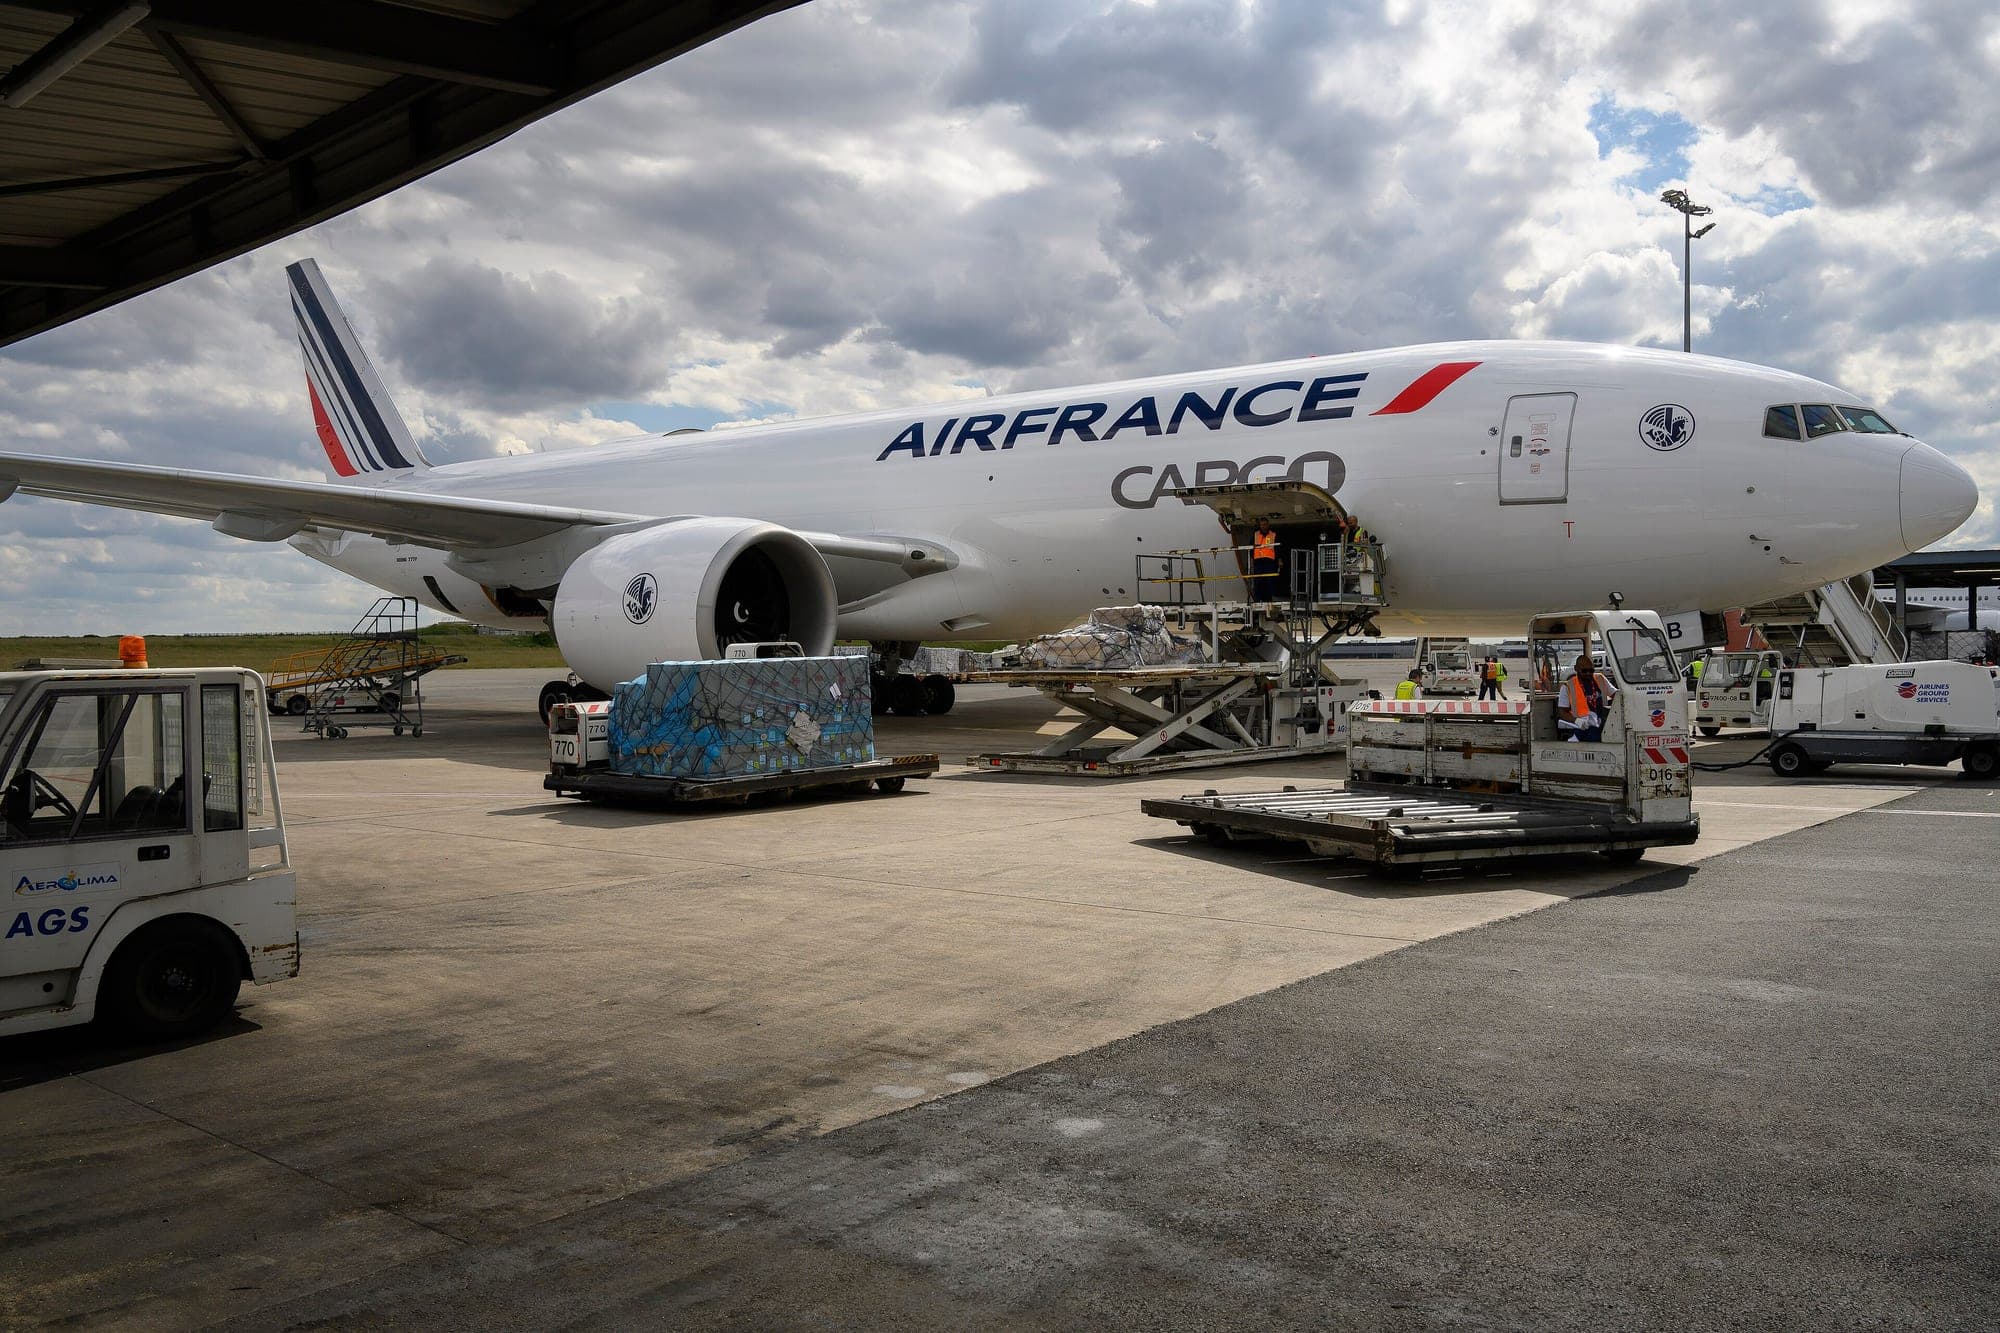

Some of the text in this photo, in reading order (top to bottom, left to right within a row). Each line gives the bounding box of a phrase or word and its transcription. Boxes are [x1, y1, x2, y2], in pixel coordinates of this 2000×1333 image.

[876, 372, 1369, 462] AIRFRANCE
[733, 649, 746, 658] 770
[588, 724, 607, 734] 770
[554, 739, 576, 757] 770
[1661, 737, 1682, 745] TEAM
[5, 906, 90, 939] AGS
